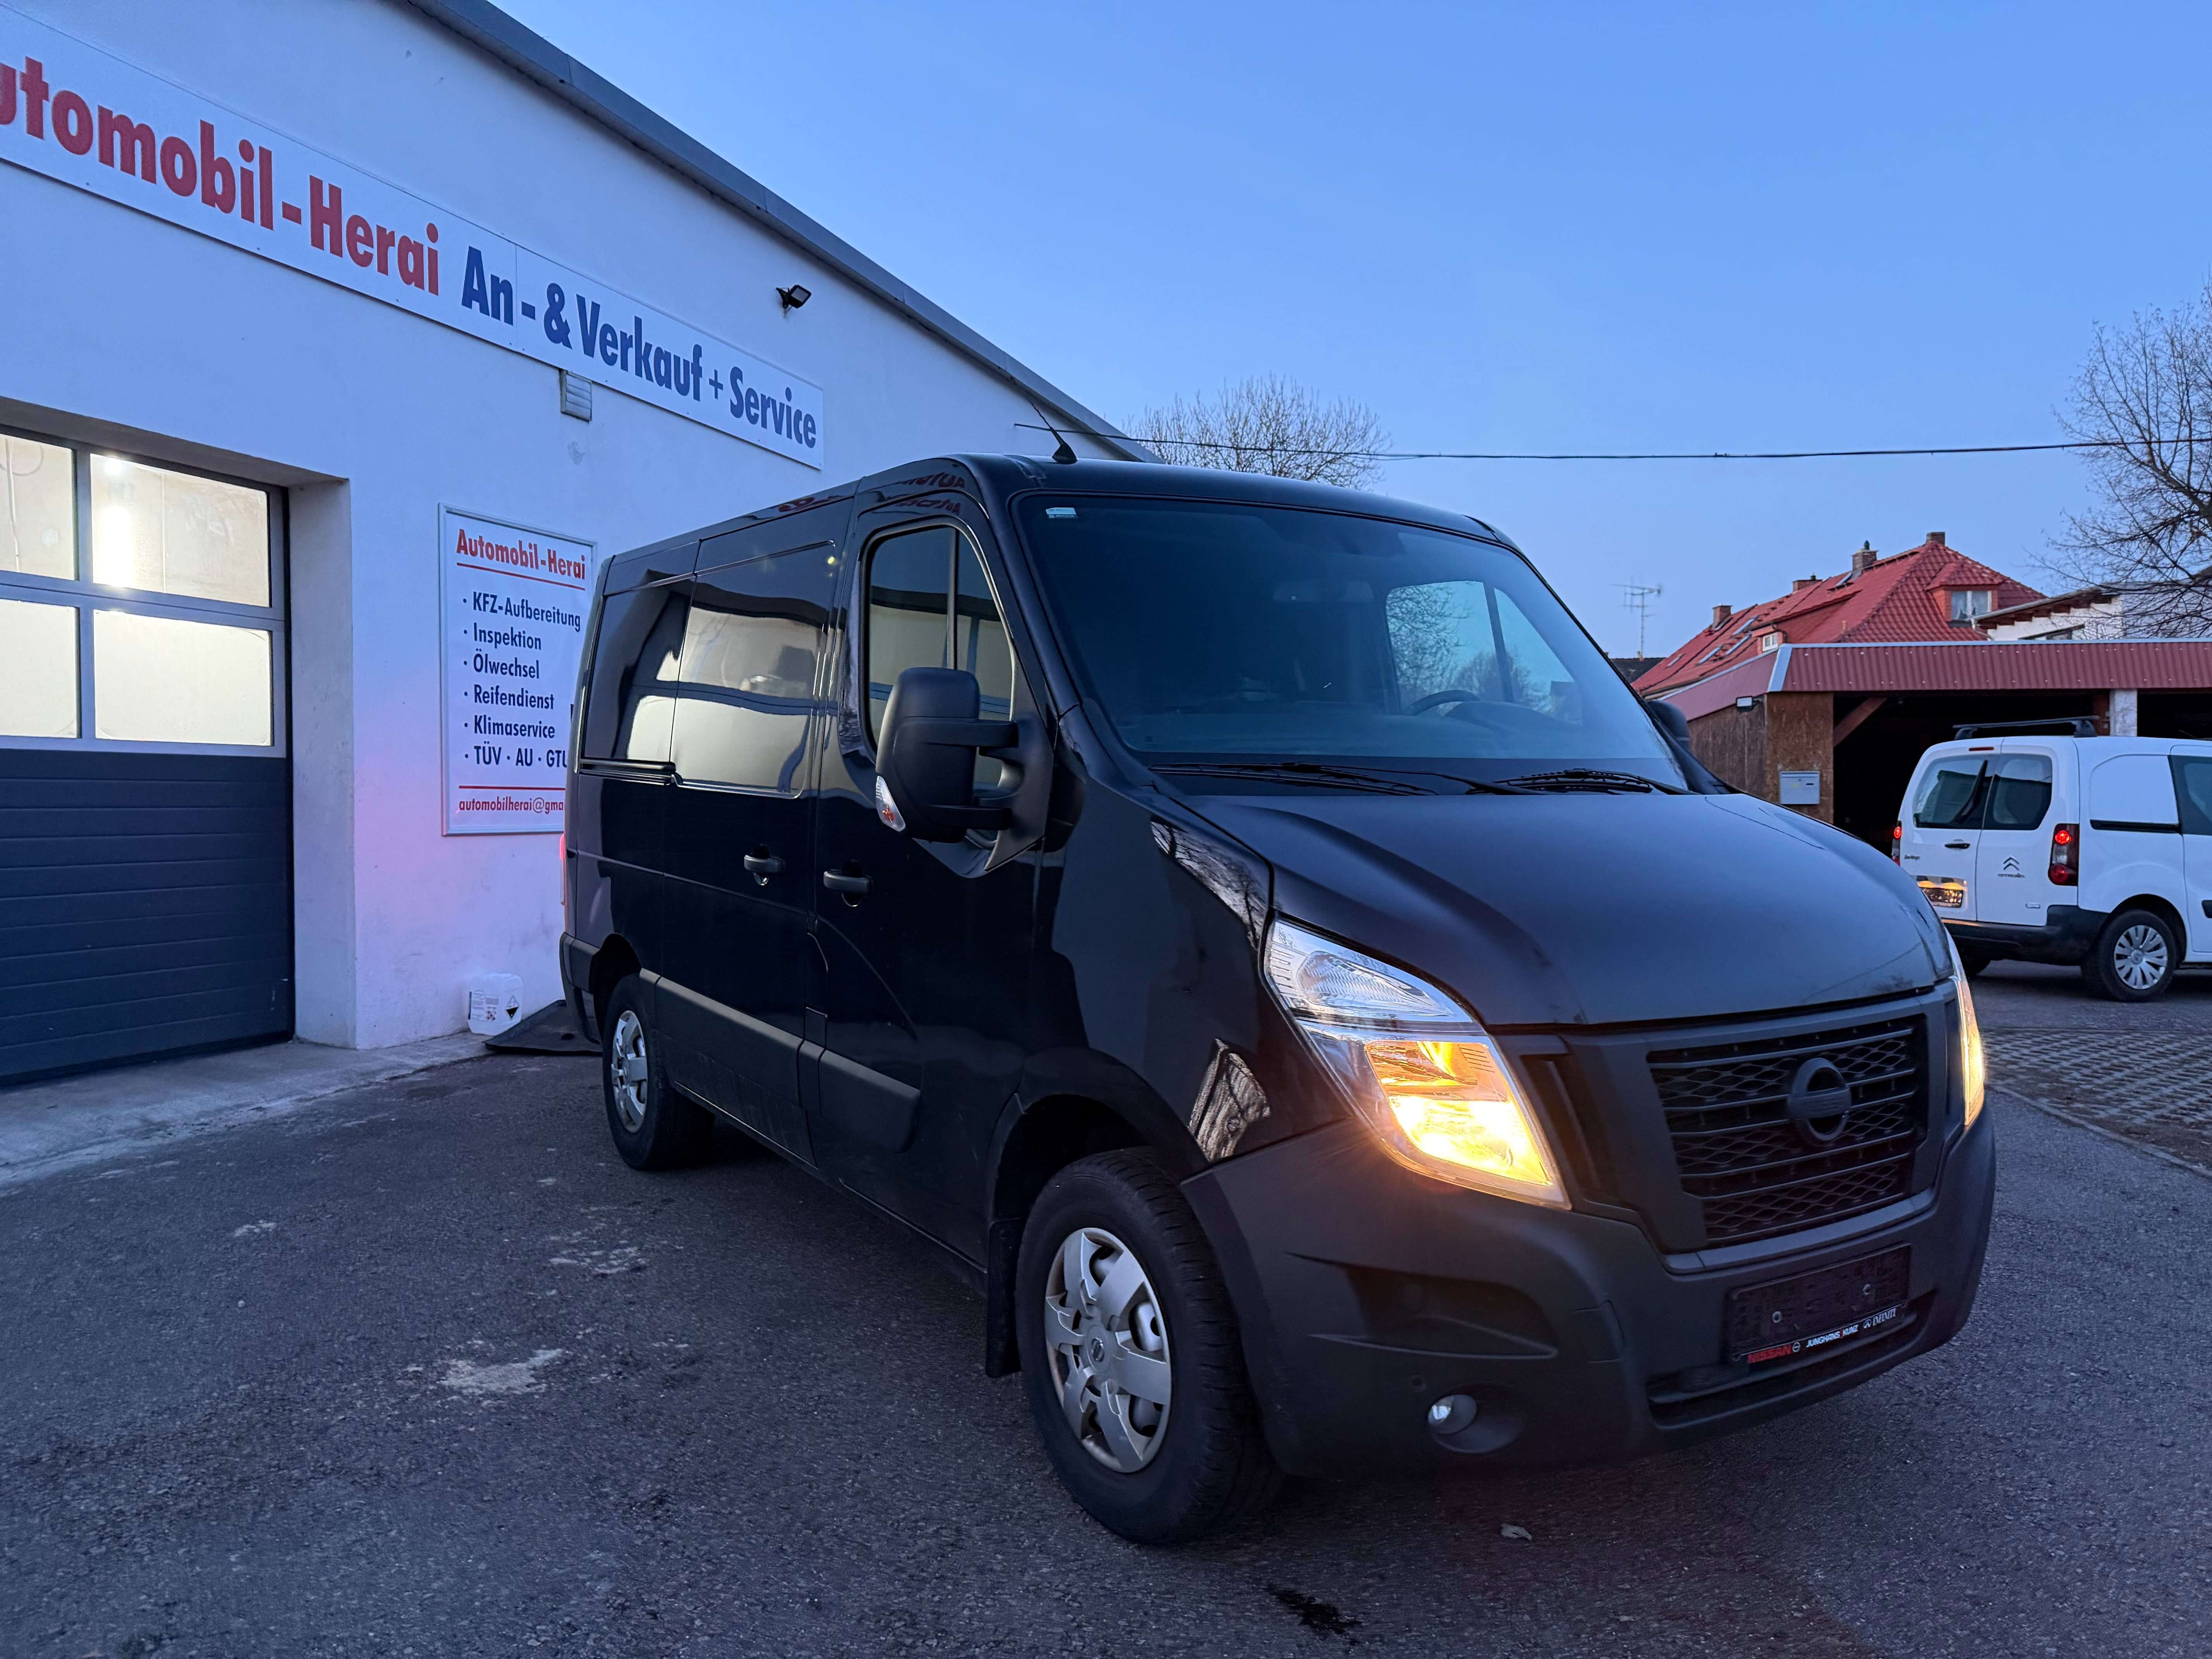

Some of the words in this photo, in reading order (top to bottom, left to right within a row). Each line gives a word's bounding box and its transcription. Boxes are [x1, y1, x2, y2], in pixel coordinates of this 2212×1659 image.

[544, 283, 572, 349] &
[576, 294, 702, 402] Verkauf
[709, 369, 723, 399] +
[730, 366, 816, 448] Service
[457, 529, 585, 580] Automobil-Herai
[473, 591, 580, 632] KFZ-Aufbereitung
[474, 622, 541, 650] Inspektion
[473, 648, 539, 679] Ölwechsel
[474, 684, 554, 709] Reifendienst
[474, 714, 555, 738] Klimaservice
[474, 741, 501, 765] TÜV
[515, 748, 533, 766] AU
